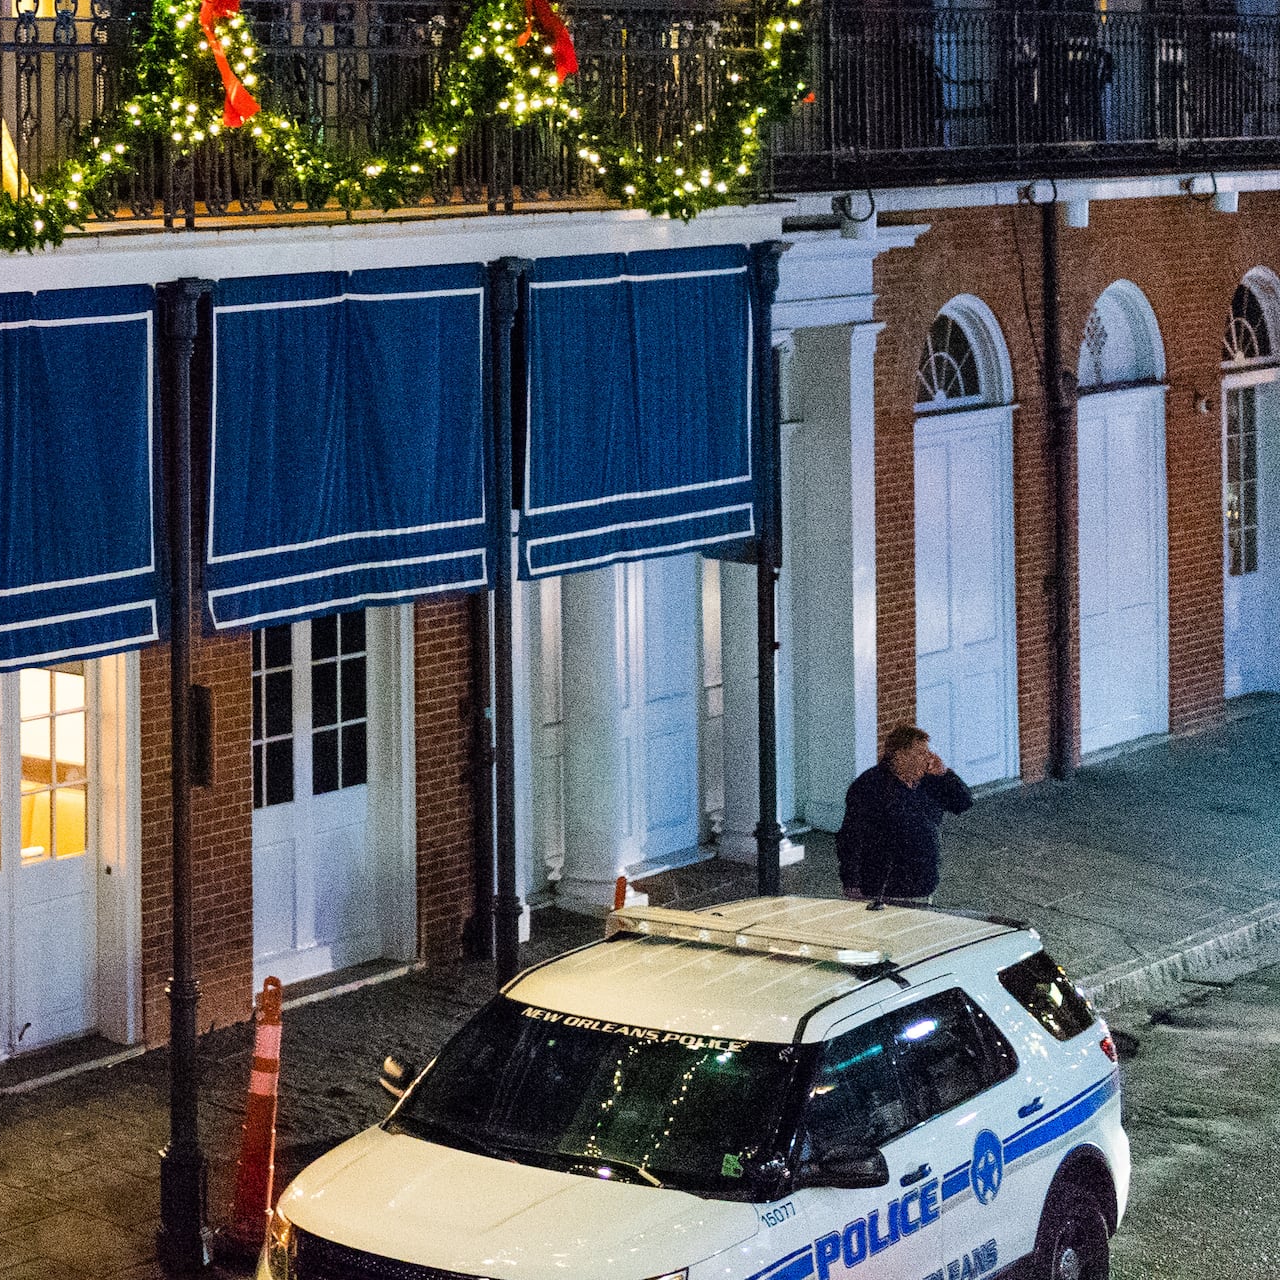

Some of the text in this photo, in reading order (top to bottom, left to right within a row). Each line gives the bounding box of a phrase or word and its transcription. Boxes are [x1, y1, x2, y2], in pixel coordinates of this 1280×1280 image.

[521, 1007, 744, 1053] NEW ORLEANS POLICE
[813, 1177, 941, 1280] POLICE
